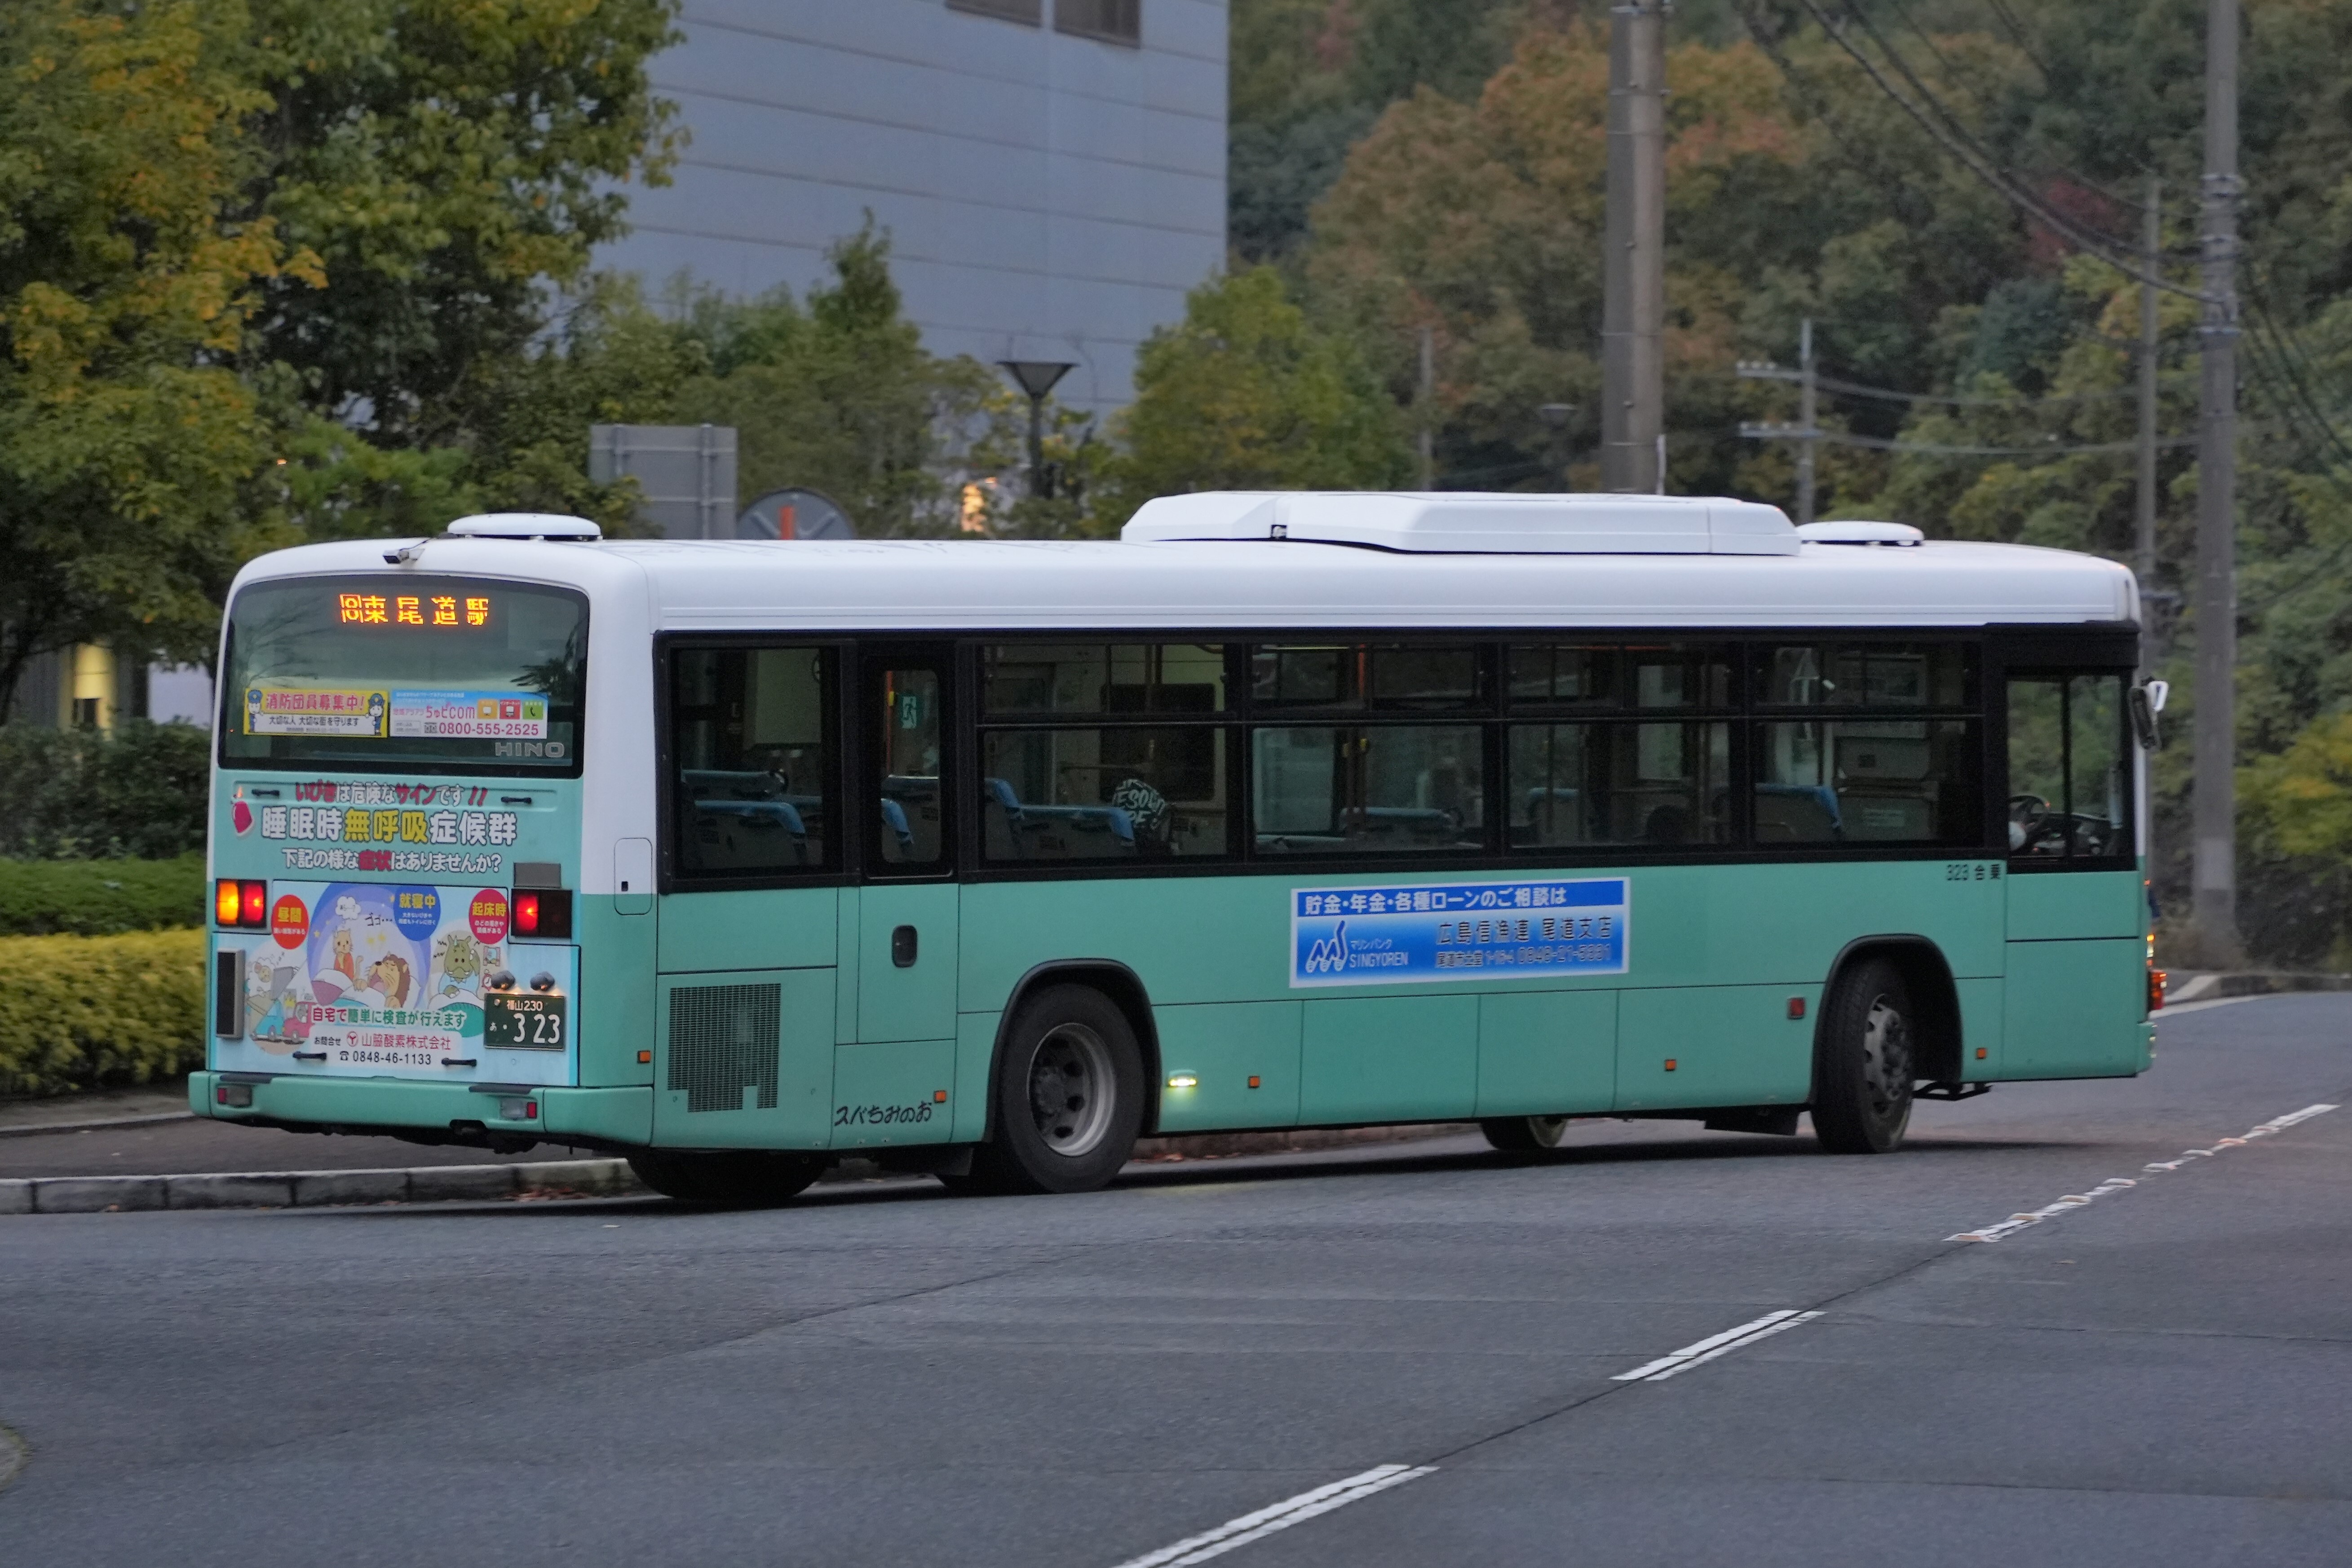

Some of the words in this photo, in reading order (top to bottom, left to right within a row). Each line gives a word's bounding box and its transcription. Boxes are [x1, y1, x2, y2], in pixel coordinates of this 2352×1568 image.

[438, 722, 539, 736] 0800-555-2525
[495, 742, 565, 758] HINO
[261, 805, 517, 846] 睡眠時無呼吸症候群
[472, 902, 507, 917] 起床時
[1349, 951, 1409, 968] SINGYOREN
[353, 1051, 432, 1065] 0848-46-1133
